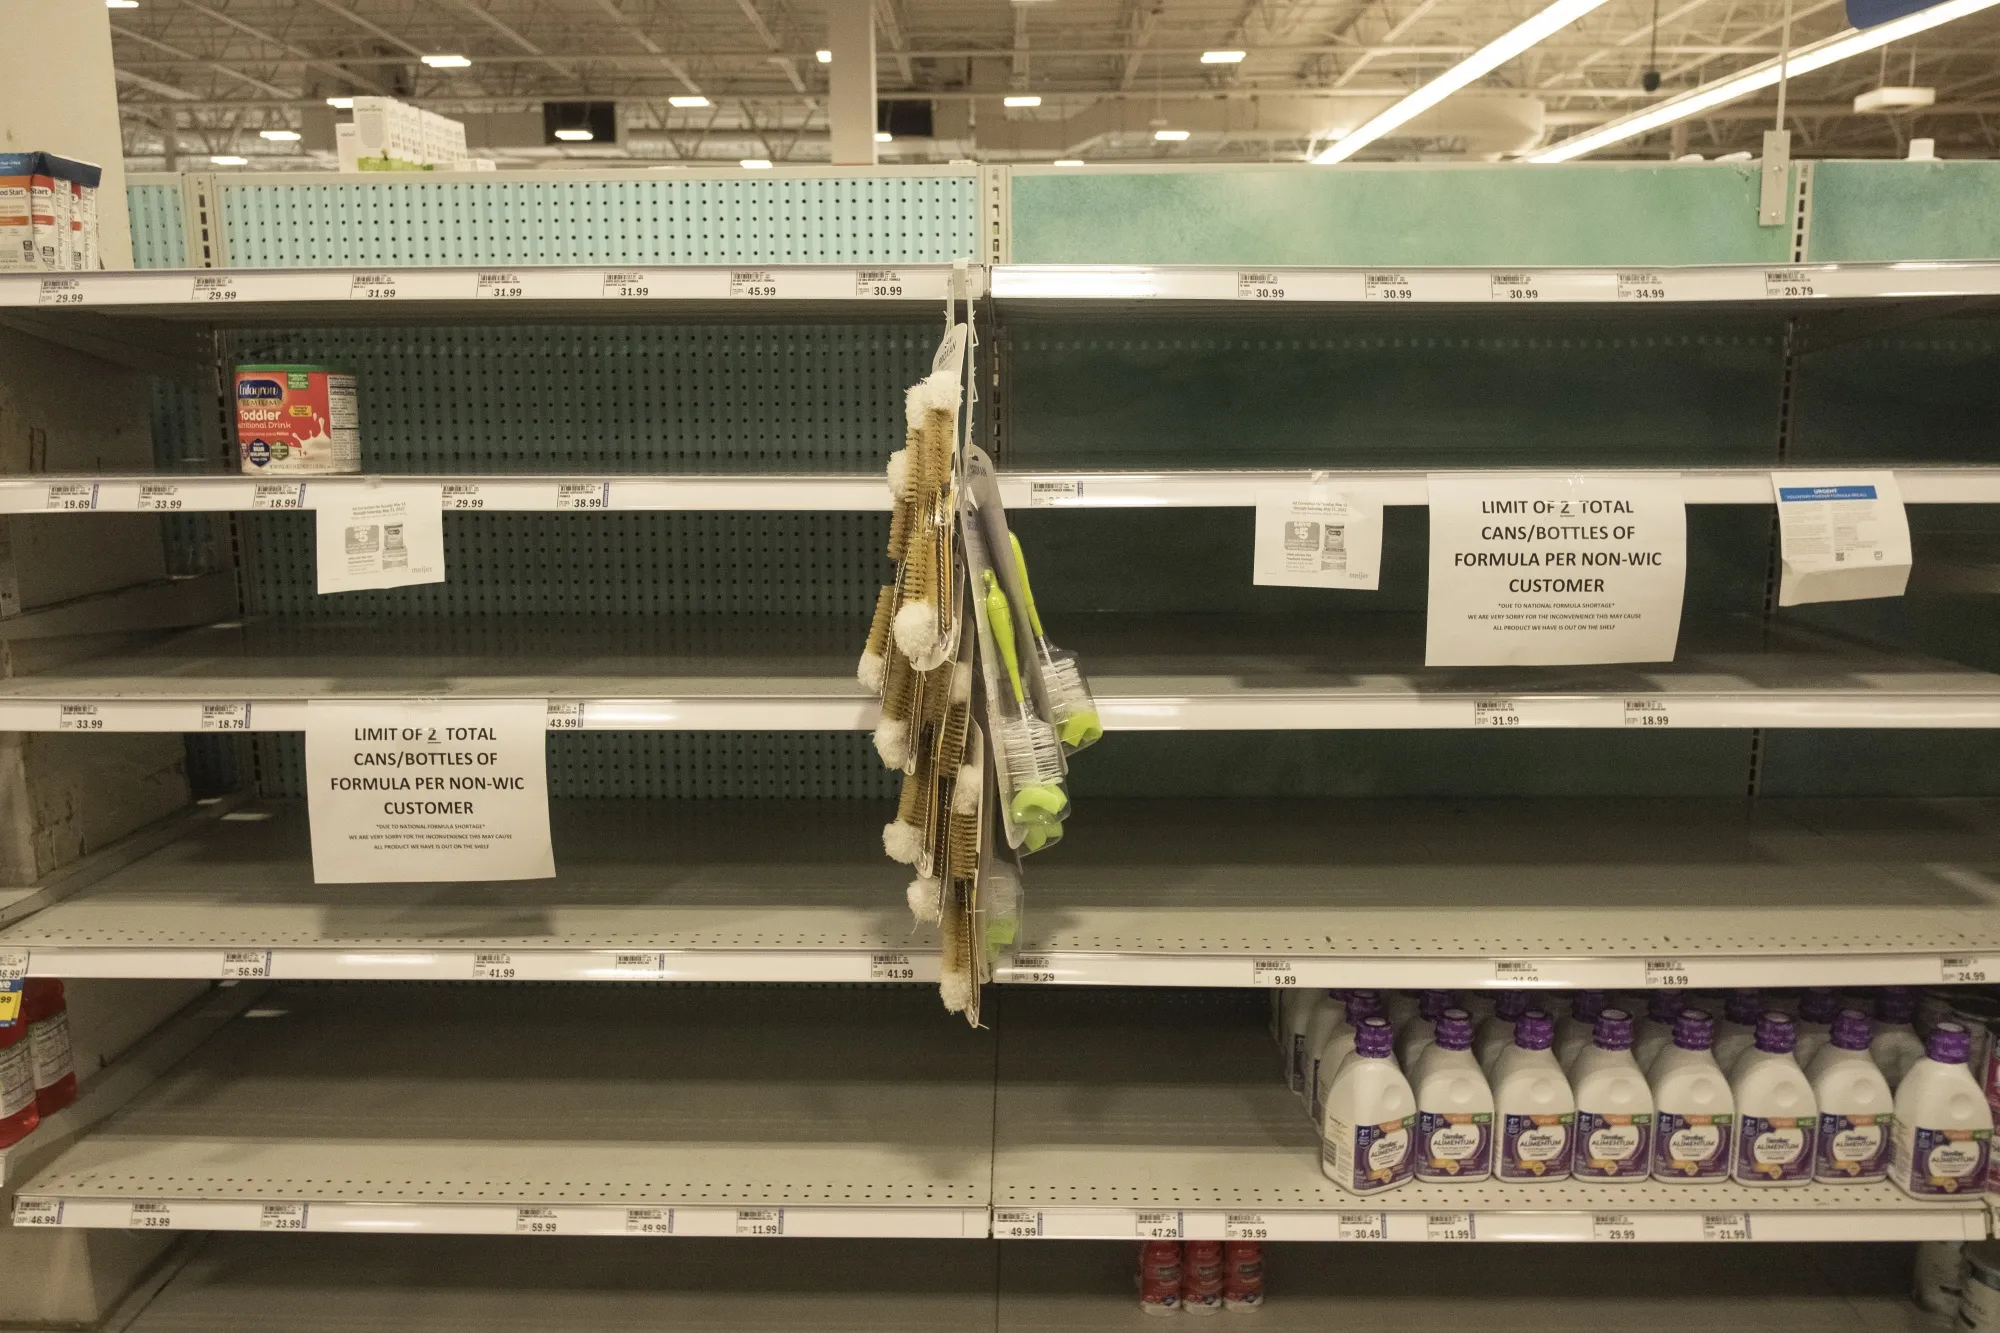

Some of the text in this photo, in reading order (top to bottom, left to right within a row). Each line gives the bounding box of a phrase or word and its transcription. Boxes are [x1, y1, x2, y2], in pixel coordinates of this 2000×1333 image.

[748, 287, 776, 295] 45.99
[874, 287, 902, 295] 30.99
[1256, 289, 1284, 297] 30.99
[1384, 290, 1411, 298] 30.99
[1510, 290, 1538, 298] 30.99
[1636, 290, 1664, 298] 34.99
[1785, 287, 1813, 295] 20.79
[56, 294, 83, 303] 29.99
[240, 410, 281, 420] Toddler
[65, 500, 90, 508] 19.69
[155, 500, 182, 508] 33.99
[270, 500, 296, 508] 18.99
[574, 499, 601, 507] 38.99
[1483, 501, 1634, 513] LIMIT OF 2 TOTAL
[1482, 525, 1634, 542] CANS/BOTTLES OF
[1455, 553, 1661, 566] FORMULA PER NON-WIC
[1510, 579, 1604, 592] CUSTOMER
[77, 720, 102, 728] 33.99
[219, 720, 243, 728] 18.79
[550, 719, 576, 727] 43.99
[1493, 716, 1519, 725] 31.99
[1643, 716, 1668, 725] 18.99
[355, 728, 496, 740] LIMIT OF 2 TOTAL
[354, 752, 497, 768] CANS/BOTTLES OF
[331, 777, 524, 790] FORMULA PER NON-WIC
[384, 802, 473, 814] CUSTOMER
[238, 968, 263, 976] 56.99
[489, 969, 514, 977] 41.99
[888, 970, 913, 978] 41.99
[1032, 973, 1054, 982] 9.29
[1275, 976, 1296, 984] 9.89
[1663, 976, 1688, 984] 18.99
[1959, 972, 1985, 981] 24.99
[31, 1216, 55, 1224] 46.99
[146, 1218, 170, 1226] 33.99
[276, 1220, 300, 1228] 23.99
[532, 1223, 556, 1232] 59.99
[642, 1224, 666, 1232] 49.99
[753, 1226, 776, 1234] 11.99
[1011, 1228, 1036, 1236] 49.99
[1152, 1229, 1176, 1237] 47.29
[1242, 1229, 1266, 1238] 39.99
[1356, 1230, 1380, 1238] 30.49
[1445, 1230, 1469, 1239] 11.99
[1610, 1230, 1635, 1239] 29.99
[1720, 1230, 1745, 1239] 21.99
